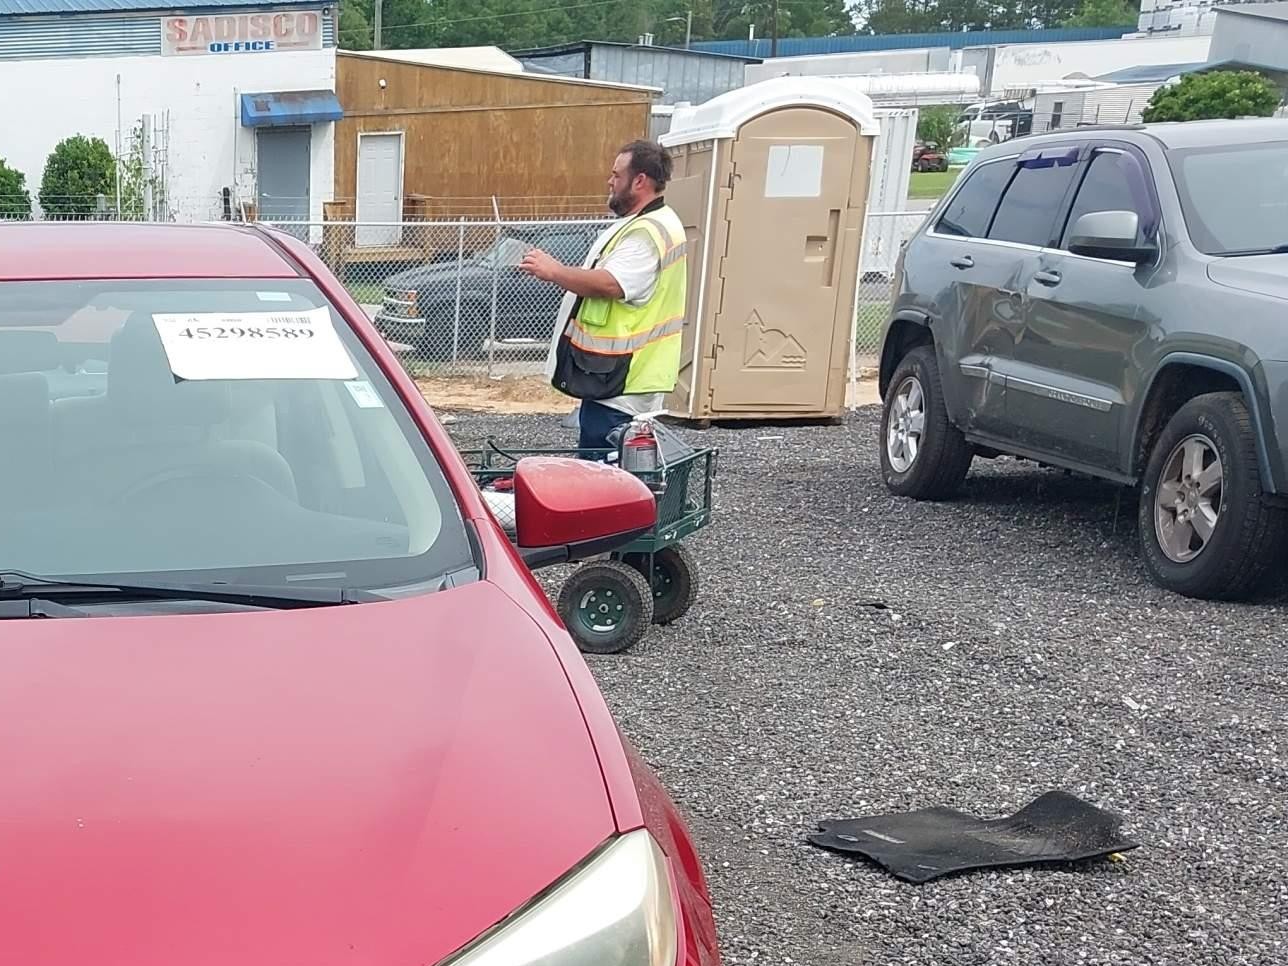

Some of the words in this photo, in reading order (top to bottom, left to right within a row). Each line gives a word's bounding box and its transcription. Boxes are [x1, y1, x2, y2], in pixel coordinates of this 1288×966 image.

[166, 13, 318, 43] SADISCO
[209, 40, 275, 52] OFFICE
[178, 327, 315, 339] 45298589
